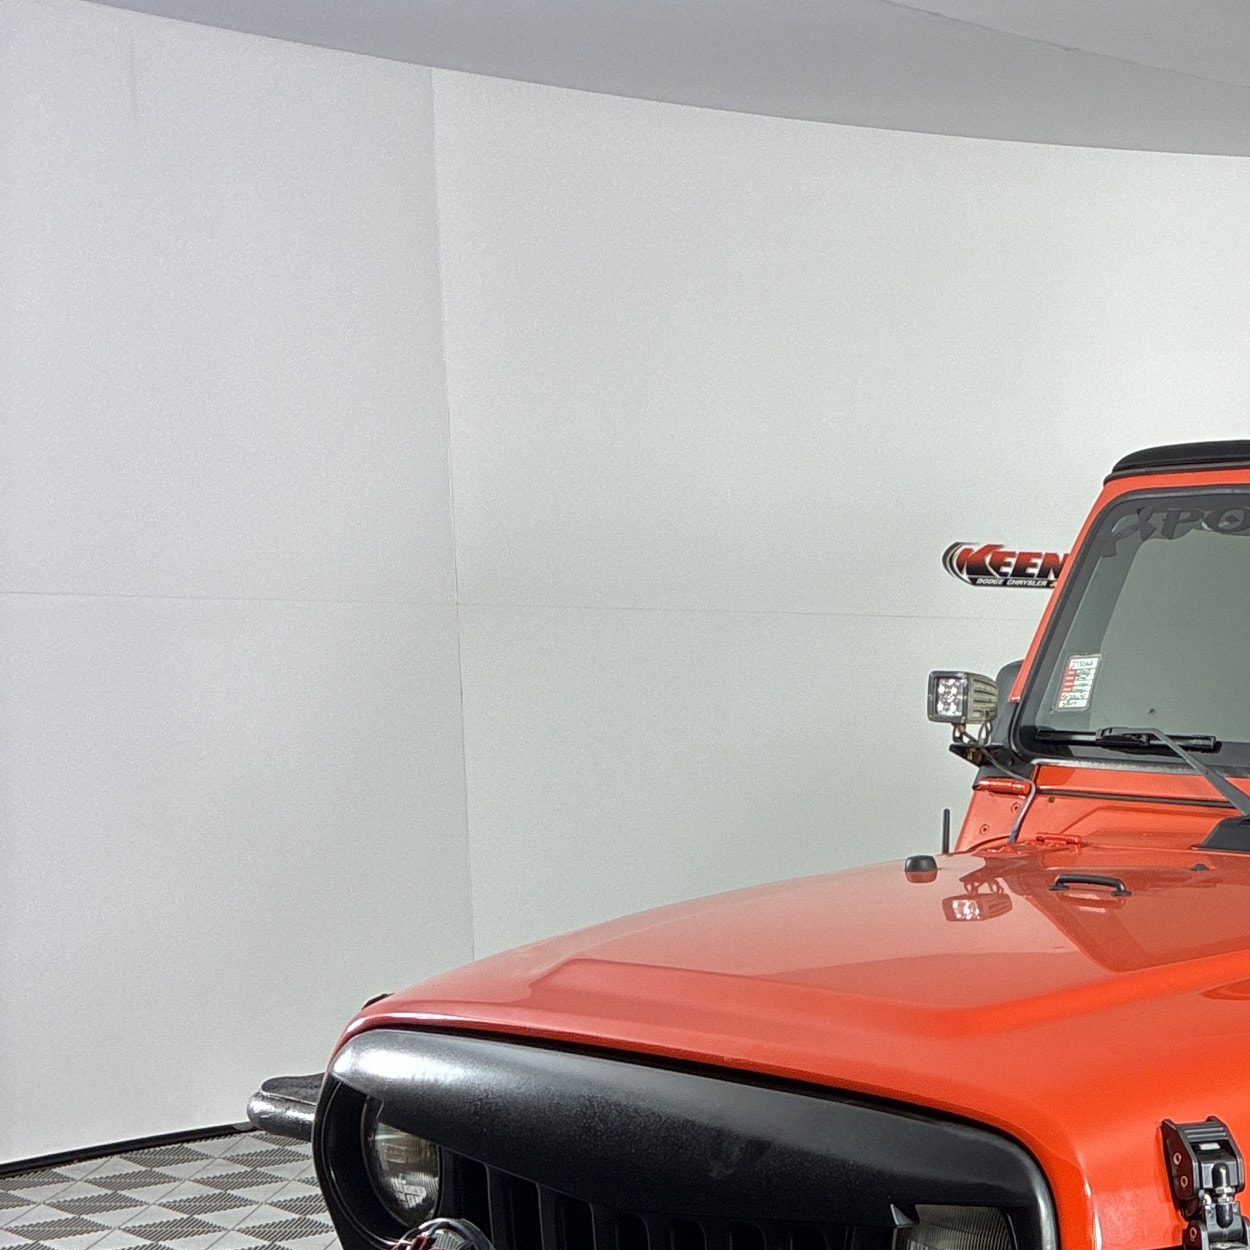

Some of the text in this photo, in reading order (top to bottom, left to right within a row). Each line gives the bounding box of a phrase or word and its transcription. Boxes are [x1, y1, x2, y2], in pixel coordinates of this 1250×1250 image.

[956, 544, 1068, 579] KEEN
[976, 577, 1004, 586] DODGE
[1006, 578, 1049, 588] CHRYSLER
